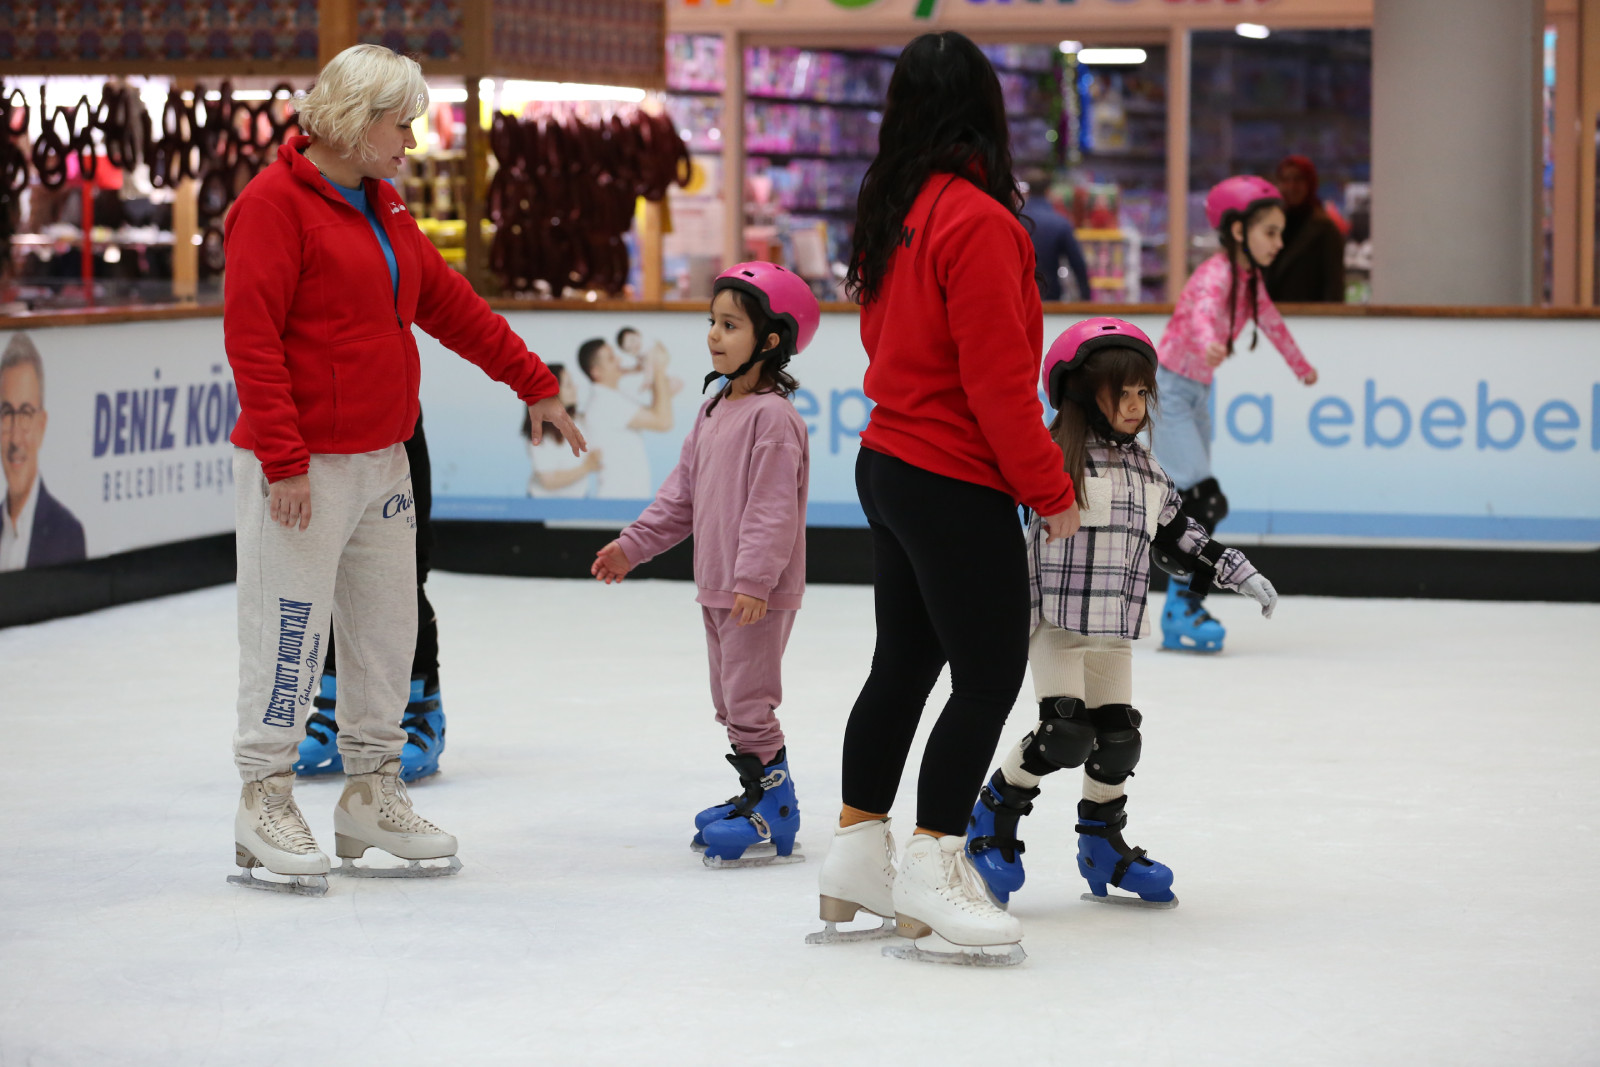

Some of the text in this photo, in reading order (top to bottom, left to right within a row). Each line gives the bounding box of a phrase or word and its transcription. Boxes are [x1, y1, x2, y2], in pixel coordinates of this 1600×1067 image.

[93, 367, 178, 459] DENİZ
[103, 461, 184, 502] BELEDİYE
[262, 597, 313, 728] CHESTNUT MOUNTAIN
[298, 674, 315, 706] Galena
